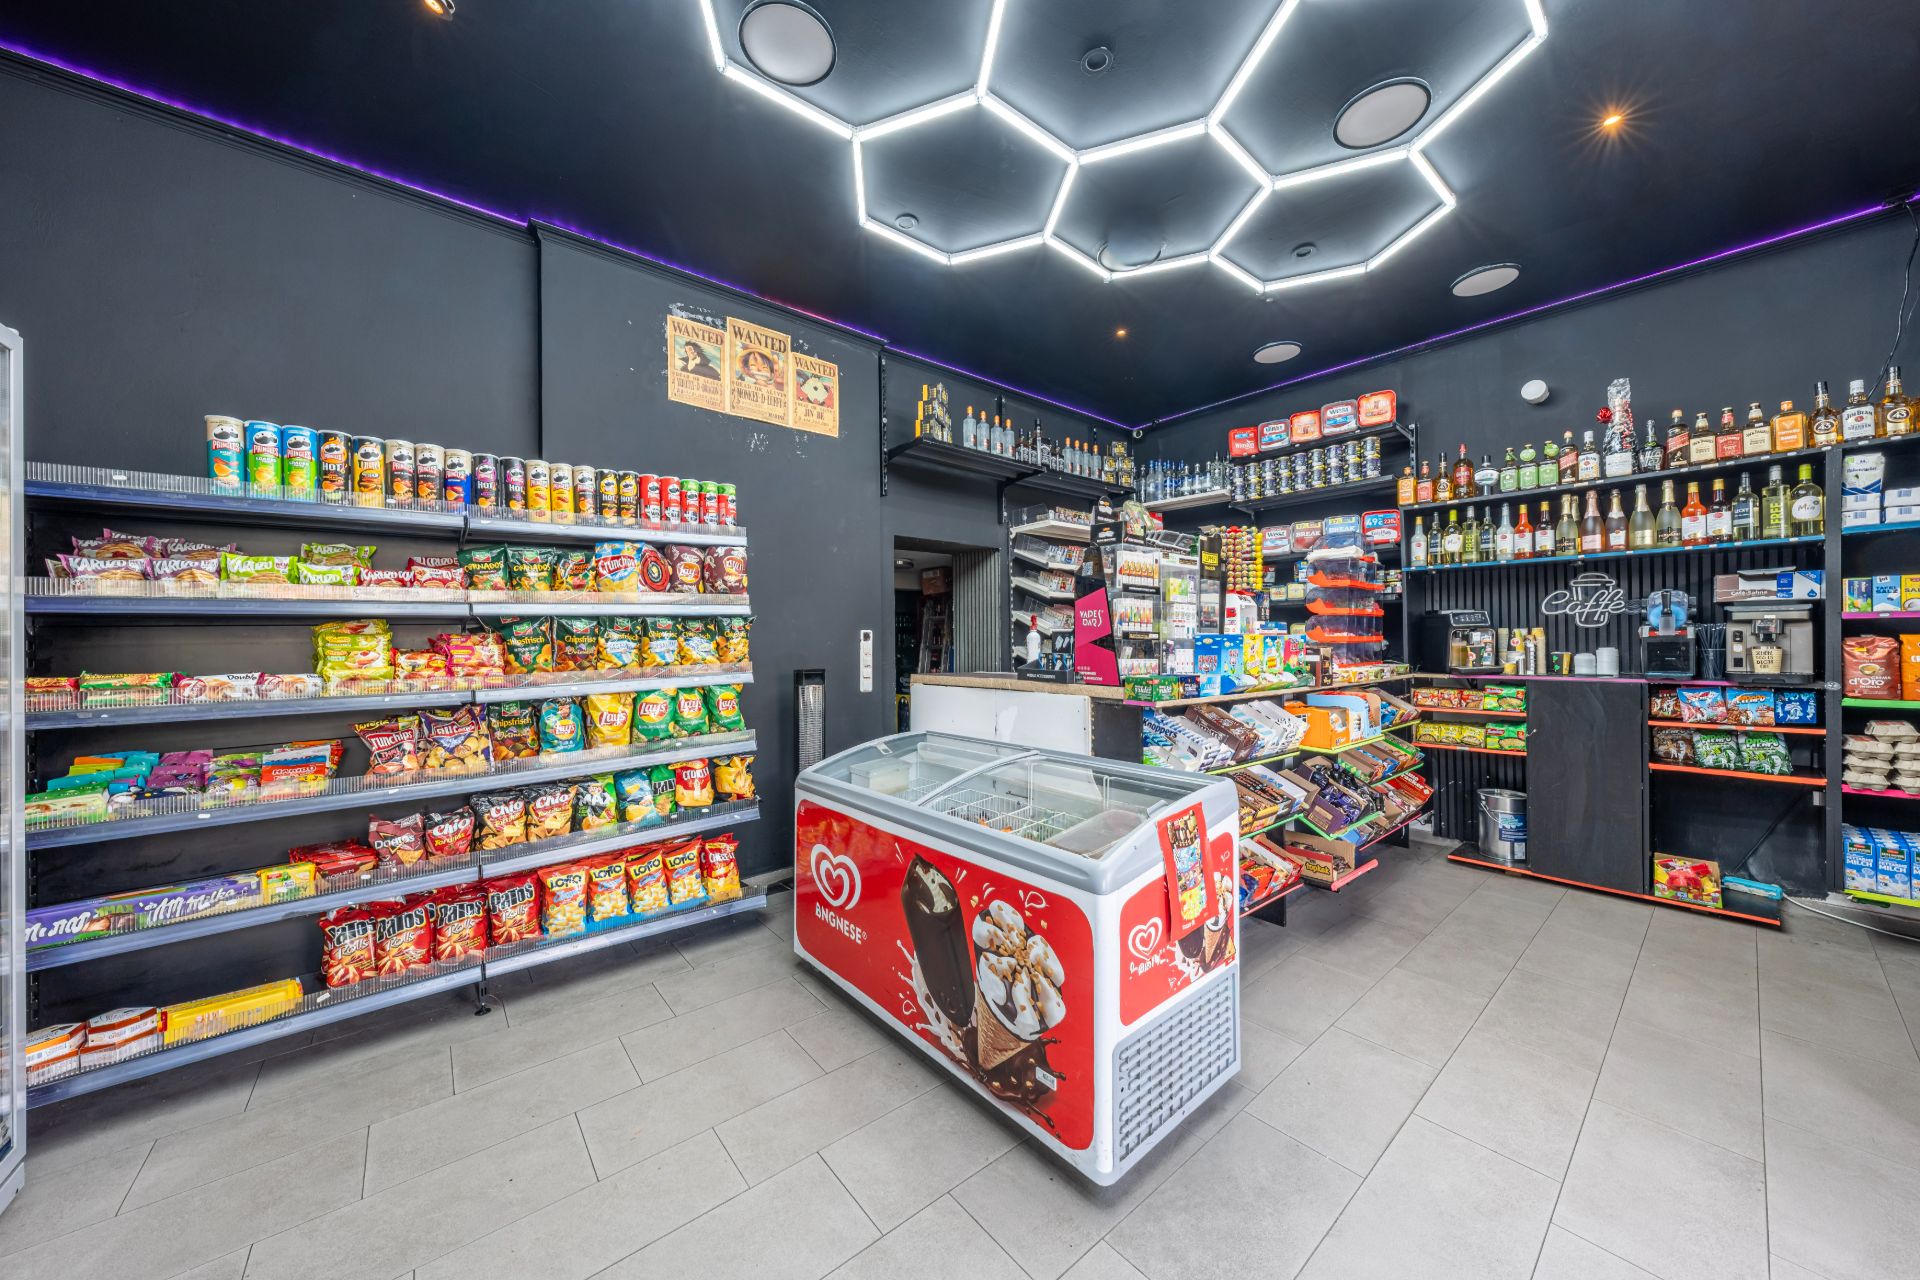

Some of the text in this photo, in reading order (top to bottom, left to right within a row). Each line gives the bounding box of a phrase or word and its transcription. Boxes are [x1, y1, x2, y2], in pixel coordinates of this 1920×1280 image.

[672, 320, 724, 346] WANTED
[733, 325, 787, 353] WANTED
[793, 356, 836, 378] WANTED
[736, 381, 751, 389] DEAD
[804, 409, 825, 420] JIN BE
[212, 440, 241, 452] PRINGLES
[252, 444, 279, 458] PRINGLES
[287, 450, 312, 462] PRINGLES
[322, 462, 341, 471] HOT
[477, 481, 493, 489] HOT
[1770, 502, 1781, 528] FREE
[1465, 534, 1474, 552] FREE
[69, 557, 127, 572] KARUZO
[153, 559, 199, 576] KARUZO
[227, 556, 273, 575] KARUZO
[227, 673, 257, 681] Double
[492, 718, 532, 728] Chipsfrisch
[1143, 719, 1178, 738] Knoppers
[490, 800, 524, 818] Chio
[432, 818, 470, 837] Chio
[633, 858, 662, 877] LOTTO
[669, 851, 696, 868] LOTTO
[1847, 859, 1873, 868] MILCH
[592, 864, 623, 880] LOTTO
[1305, 861, 1331, 876] topkek
[1879, 864, 1907, 873] MILCH
[549, 874, 583, 890] LOTTO
[501, 904, 527, 921] Rolls
[446, 918, 475, 938] Rolls
[335, 939, 369, 960] Rolls
[384, 931, 415, 954] Rolls
